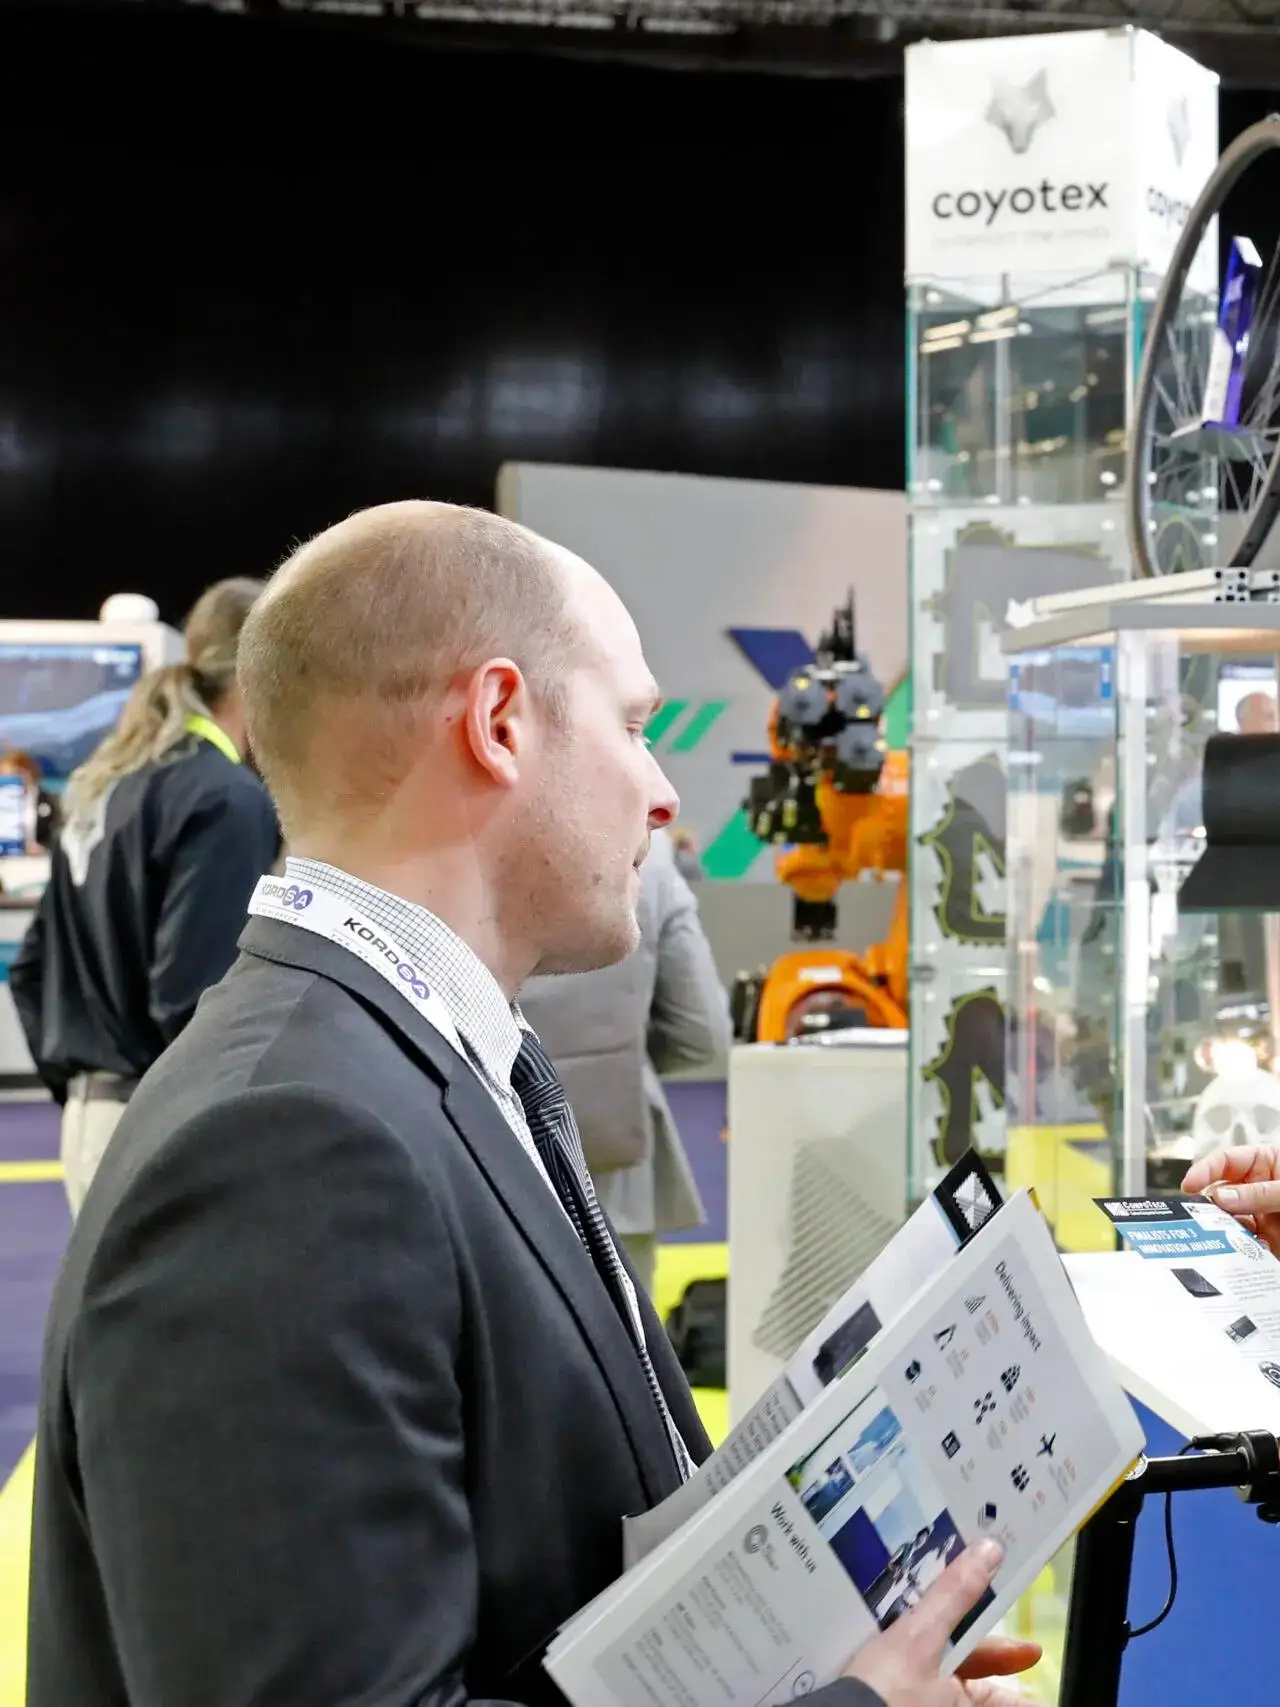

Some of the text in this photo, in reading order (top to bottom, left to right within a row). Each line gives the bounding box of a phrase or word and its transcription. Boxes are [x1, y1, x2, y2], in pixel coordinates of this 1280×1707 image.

[932, 178, 1109, 226] coyotex
[343, 917, 430, 1000] KORDSA
[1127, 1230, 1171, 1240] FINALISTS
[995, 1260, 1024, 1321] Delivering
[1020, 1311, 1042, 1352] impact
[770, 1500, 795, 1537] Work
[789, 1535, 810, 1561] with
